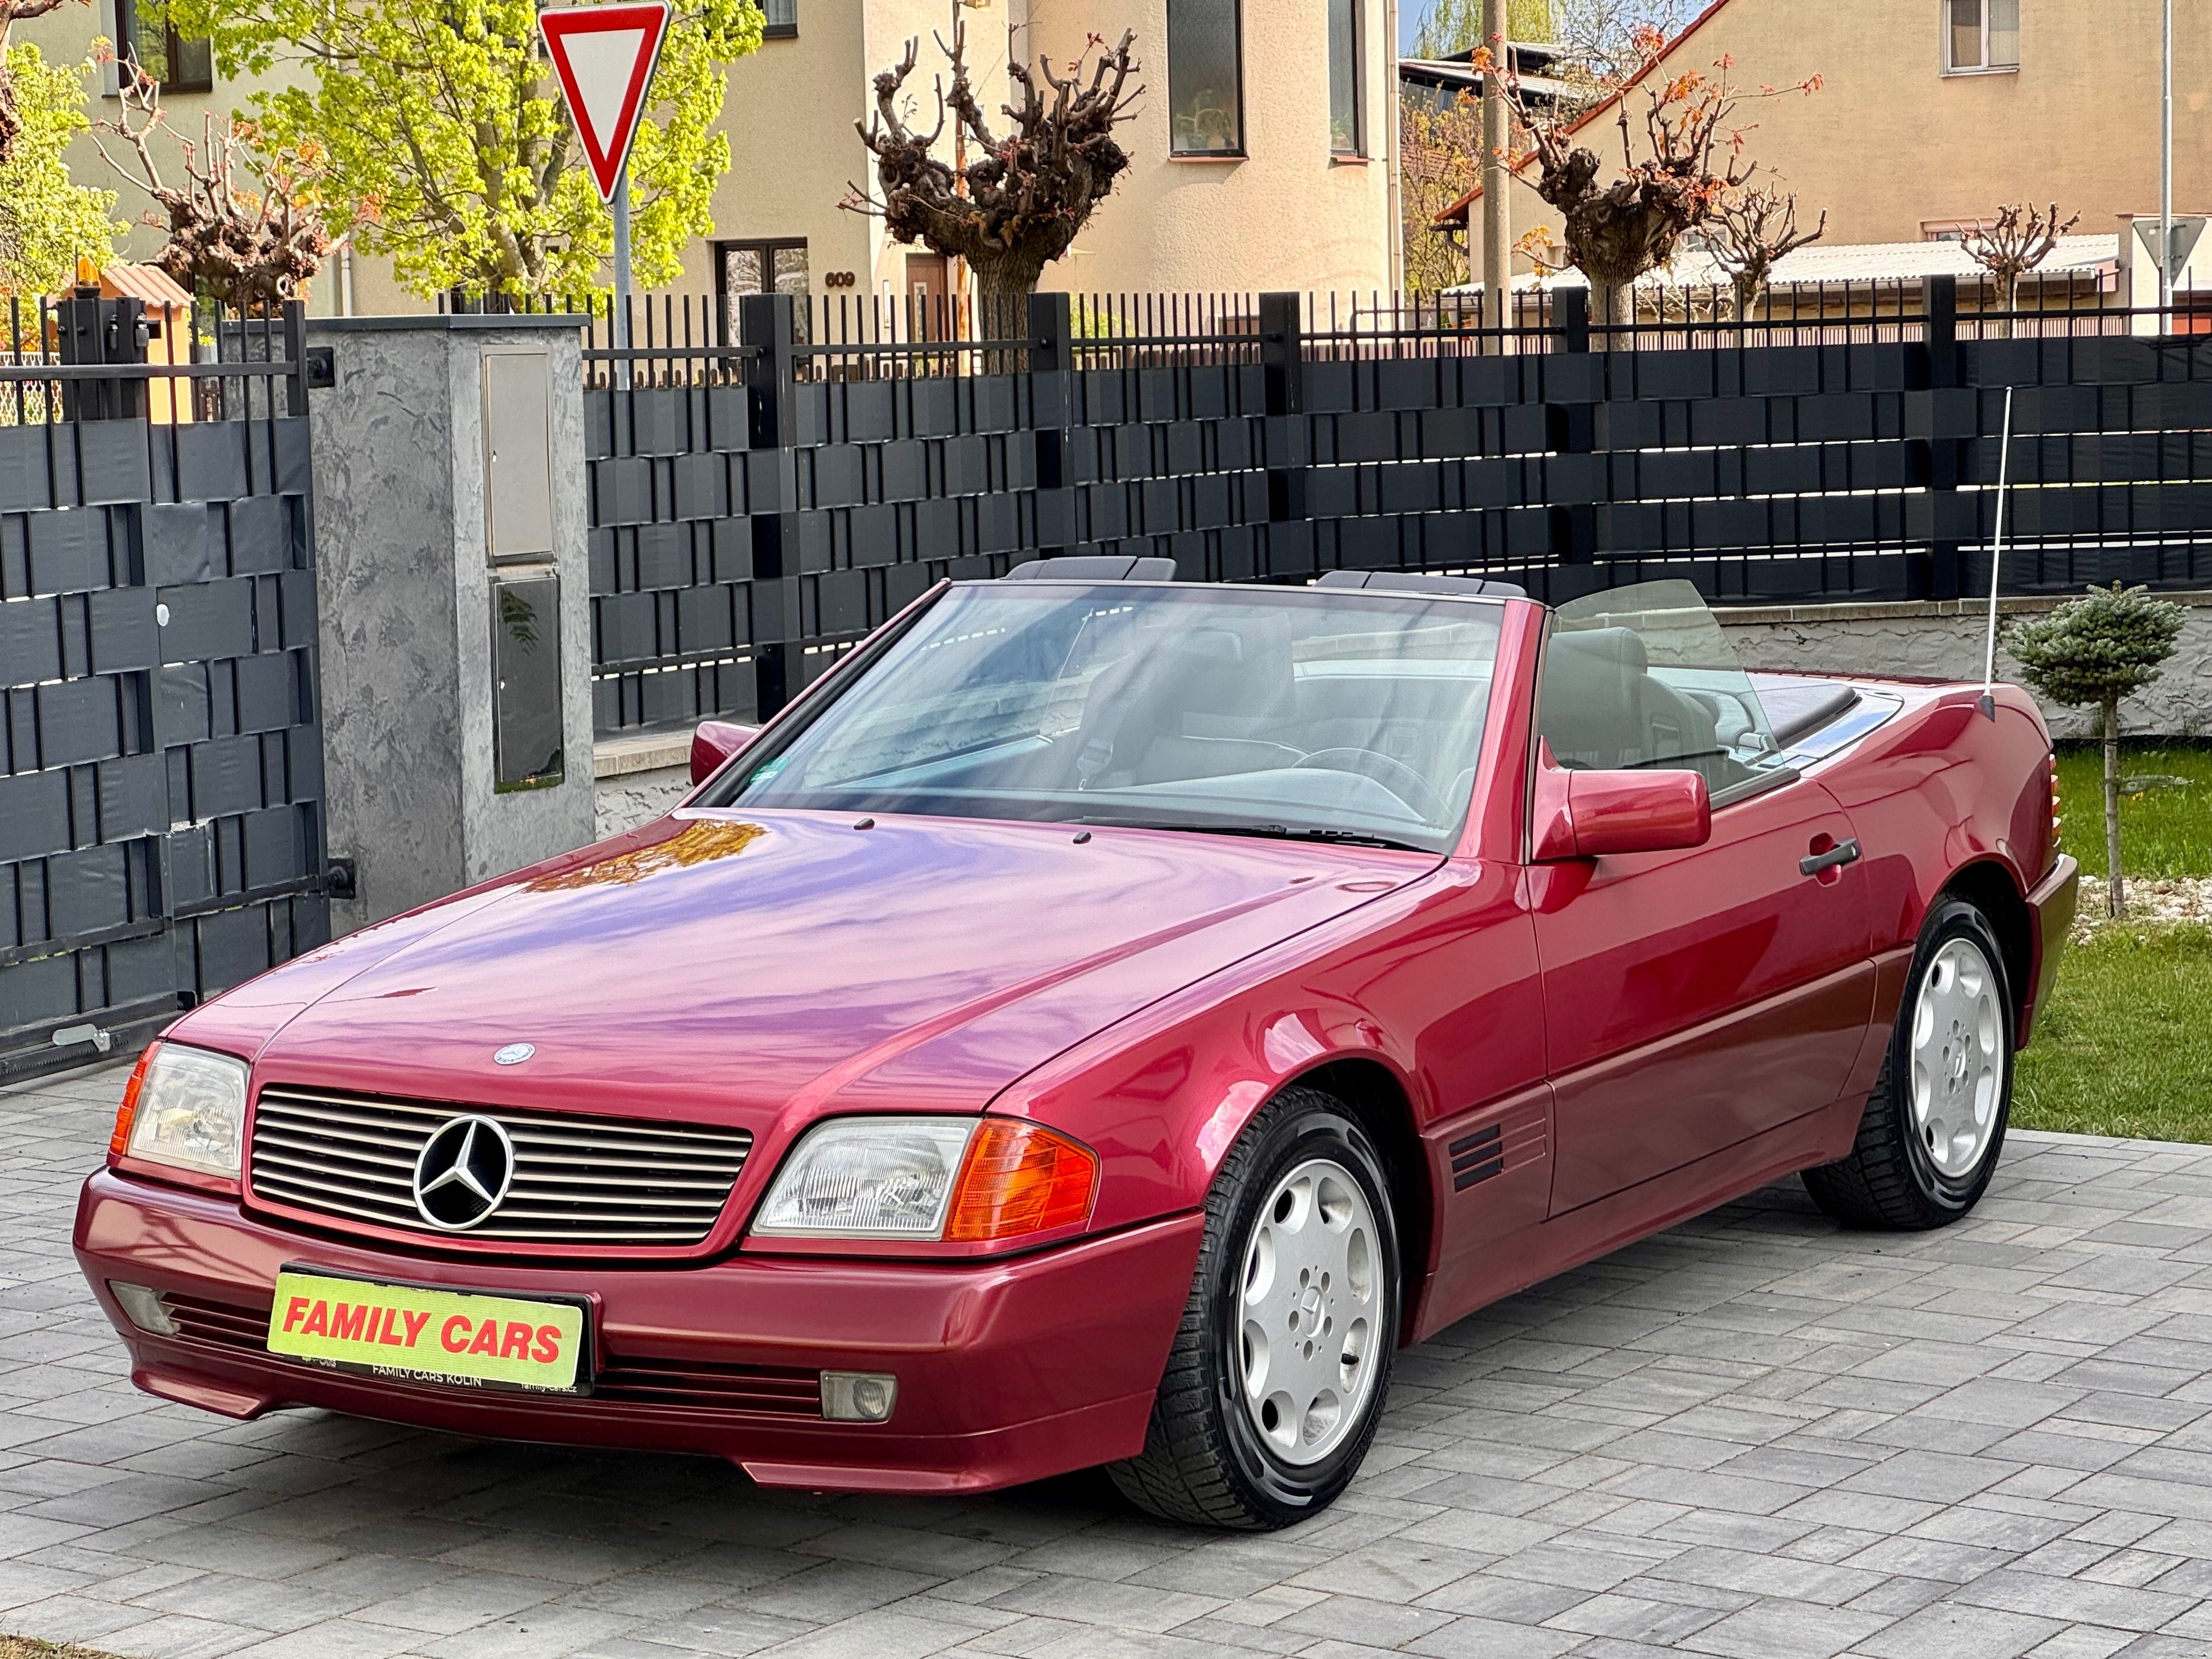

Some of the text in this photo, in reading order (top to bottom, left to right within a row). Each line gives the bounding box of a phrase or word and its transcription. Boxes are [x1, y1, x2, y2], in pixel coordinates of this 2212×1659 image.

[825, 271, 855, 287] 609
[283, 1296, 562, 1363] FAMILY CARS
[373, 1364, 411, 1379] FAMILY
[414, 1371, 444, 1383] CARS
